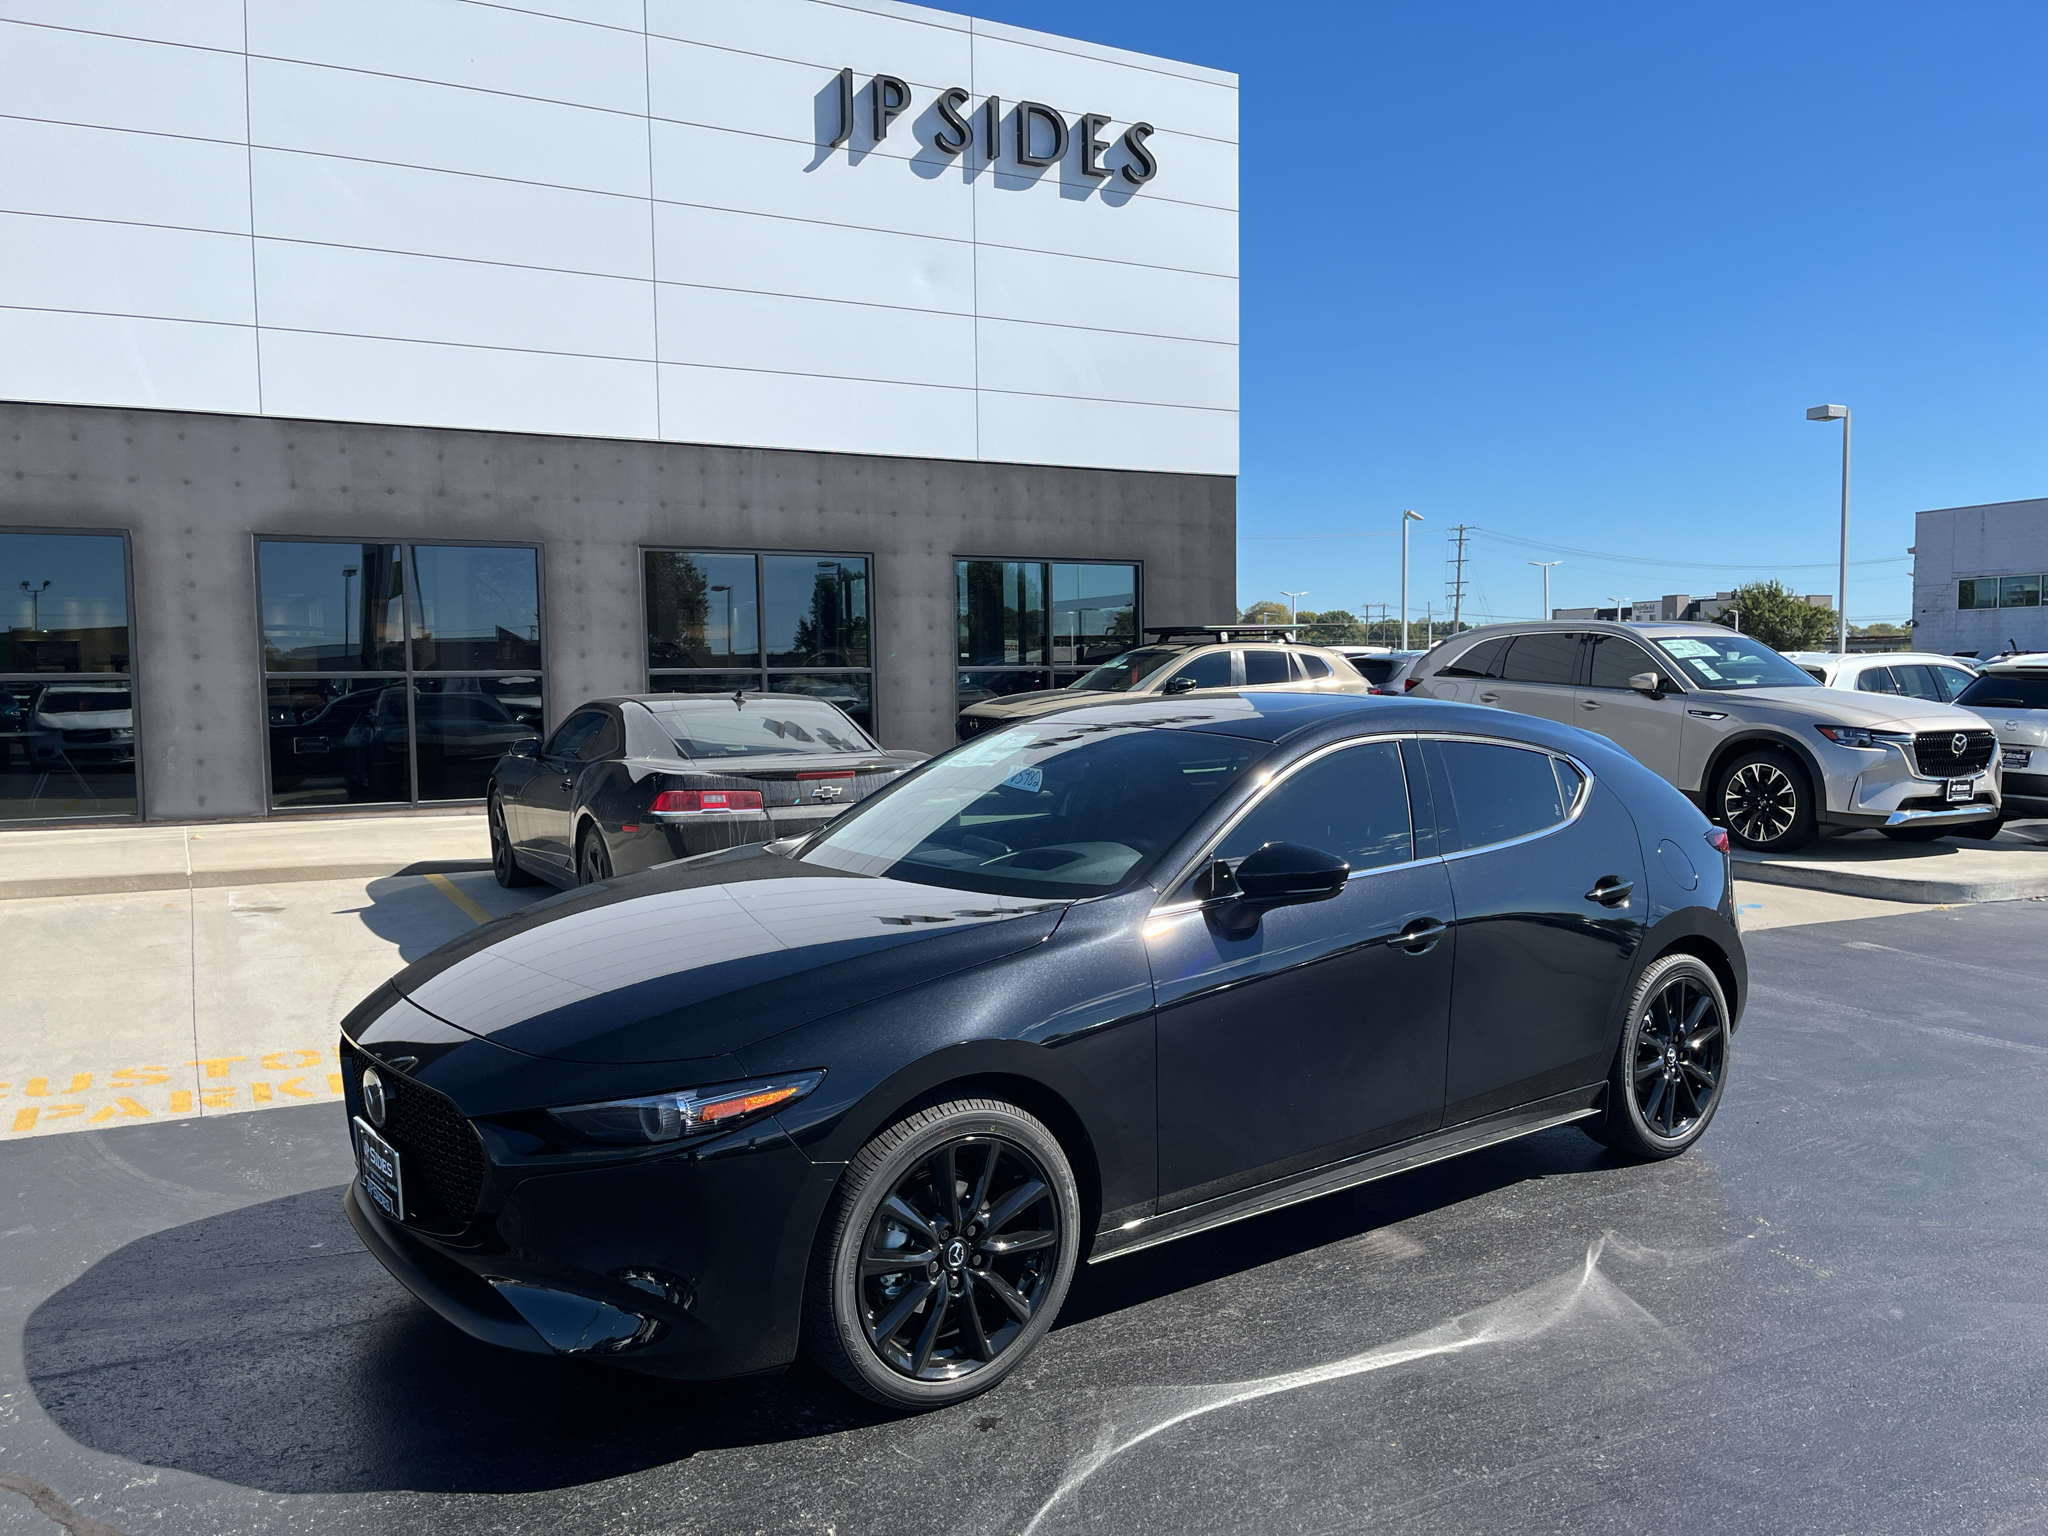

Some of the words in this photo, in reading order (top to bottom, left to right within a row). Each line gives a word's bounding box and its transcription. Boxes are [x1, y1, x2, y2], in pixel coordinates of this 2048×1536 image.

[829, 67, 912, 148] JP
[934, 87, 1158, 184] SIDES
[369, 1146, 393, 1178] SIDES
